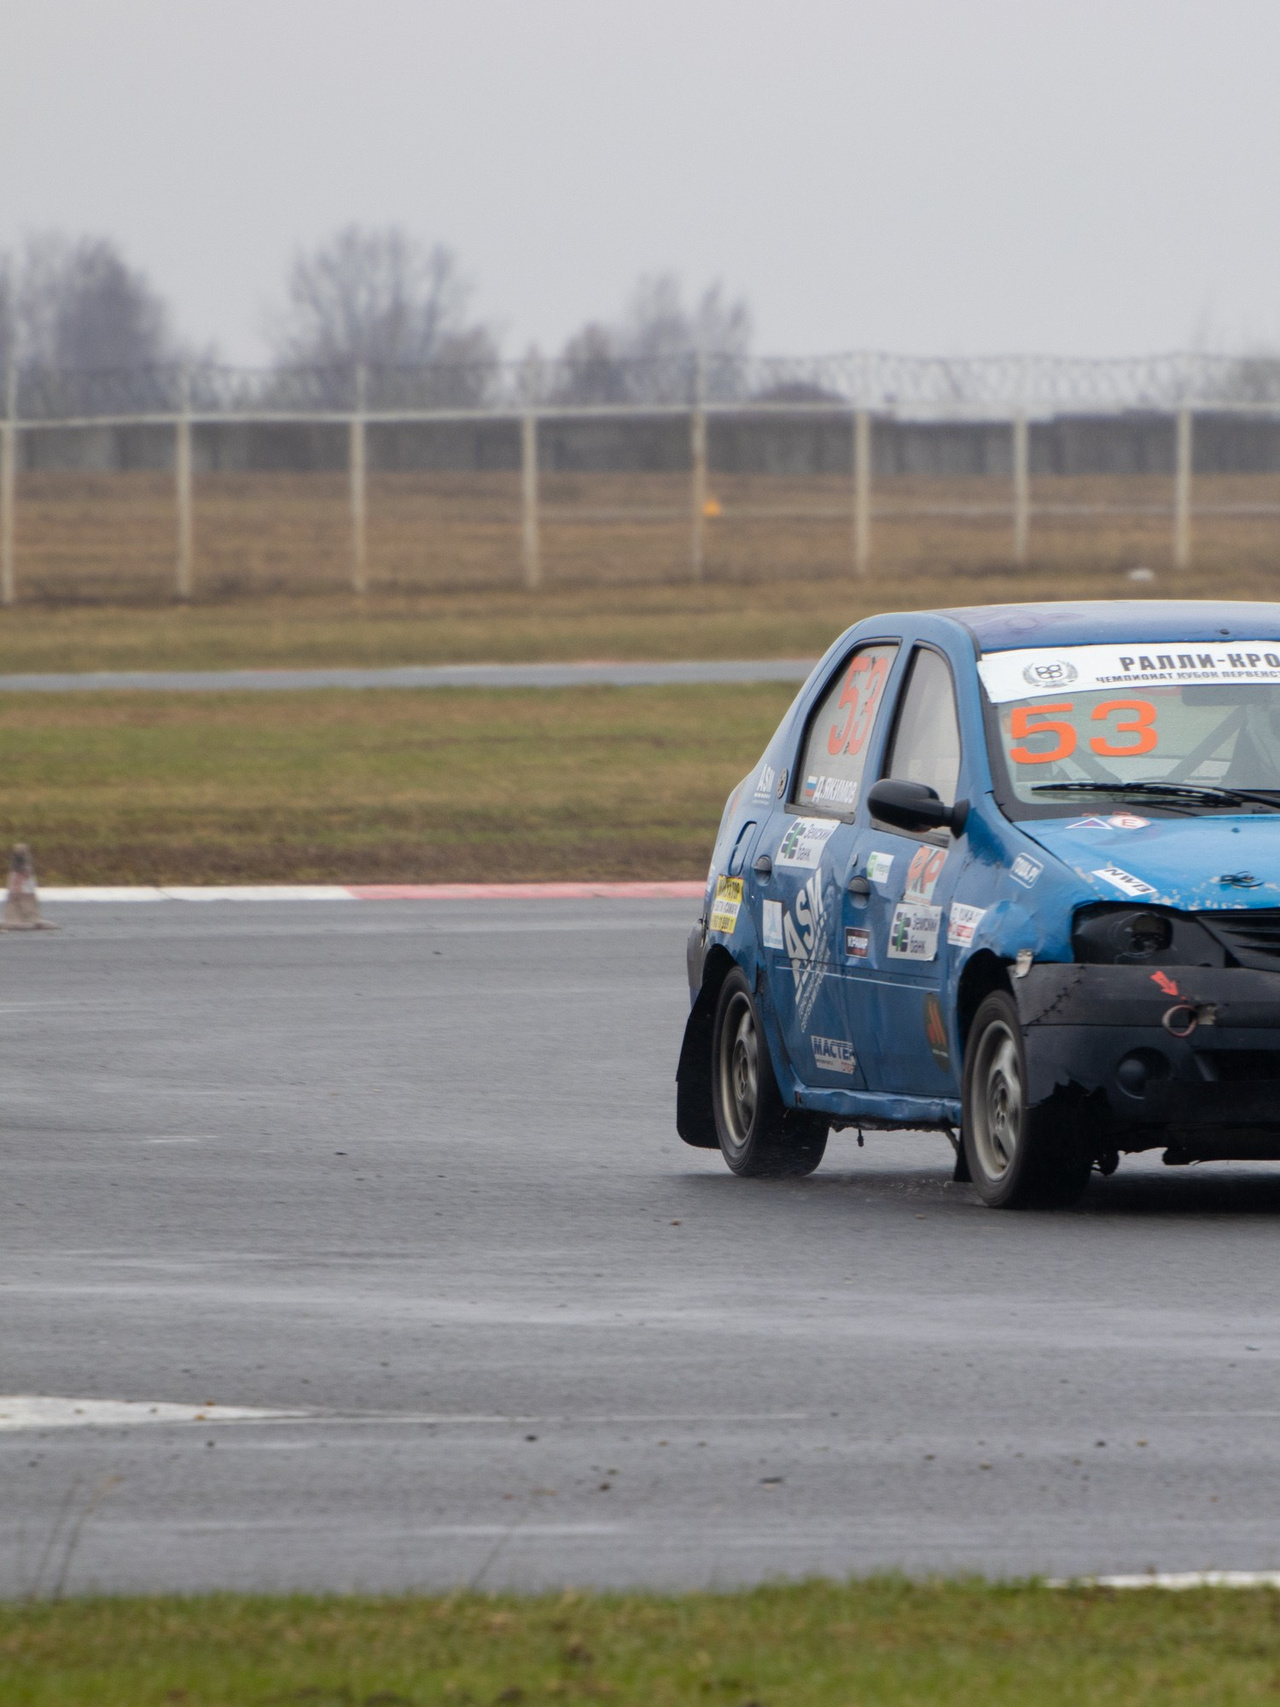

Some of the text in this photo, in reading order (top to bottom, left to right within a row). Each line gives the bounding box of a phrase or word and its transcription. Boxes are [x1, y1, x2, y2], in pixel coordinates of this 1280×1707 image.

[827, 656, 888, 756] 53
[1096, 672, 1173, 685] ЧЕМПИОНАТ
[1177, 671, 1219, 680] КУБОК
[1009, 699, 1159, 765] 53
[783, 867, 824, 988] ASM
